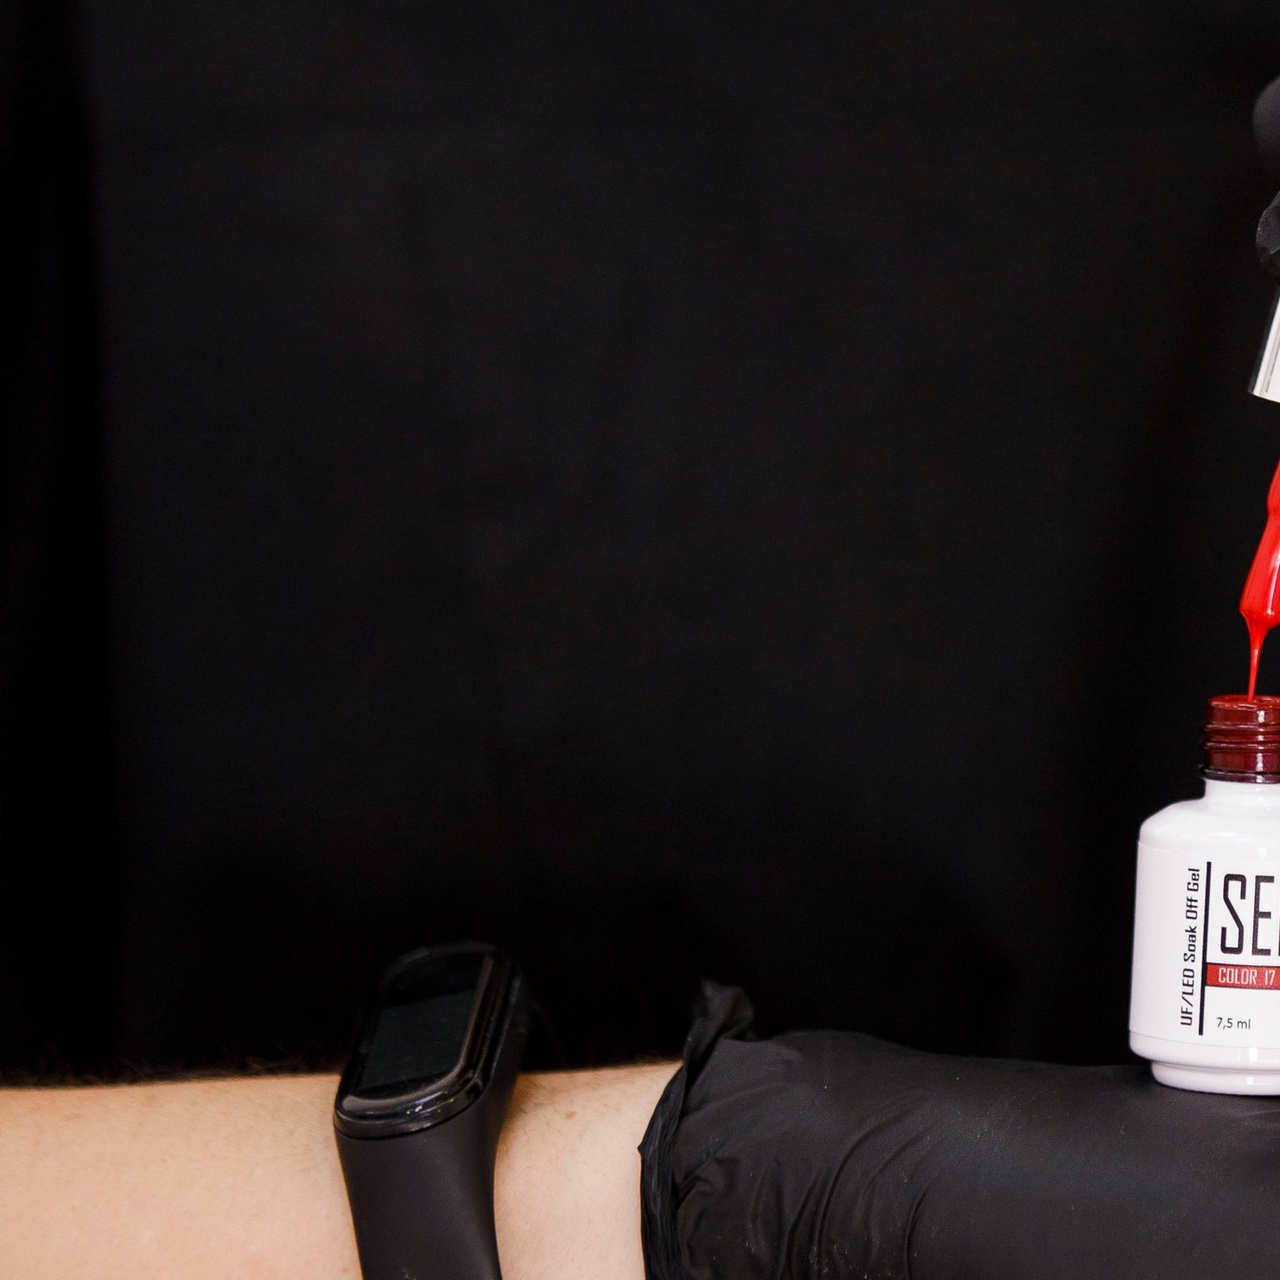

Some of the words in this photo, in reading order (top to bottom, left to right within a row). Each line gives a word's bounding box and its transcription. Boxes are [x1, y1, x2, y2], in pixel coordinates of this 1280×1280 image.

[1187, 868, 1200, 893] Gel
[1185, 896, 1199, 920] Off
[1183, 925, 1197, 962] Soak
[1218, 967, 1257, 985] COLOR
[1264, 969, 1276, 986] 17
[1180, 968, 1195, 1026] UF/LED
[1216, 1017, 1233, 1030] 7,5
[1237, 1018, 1251, 1029] ml
